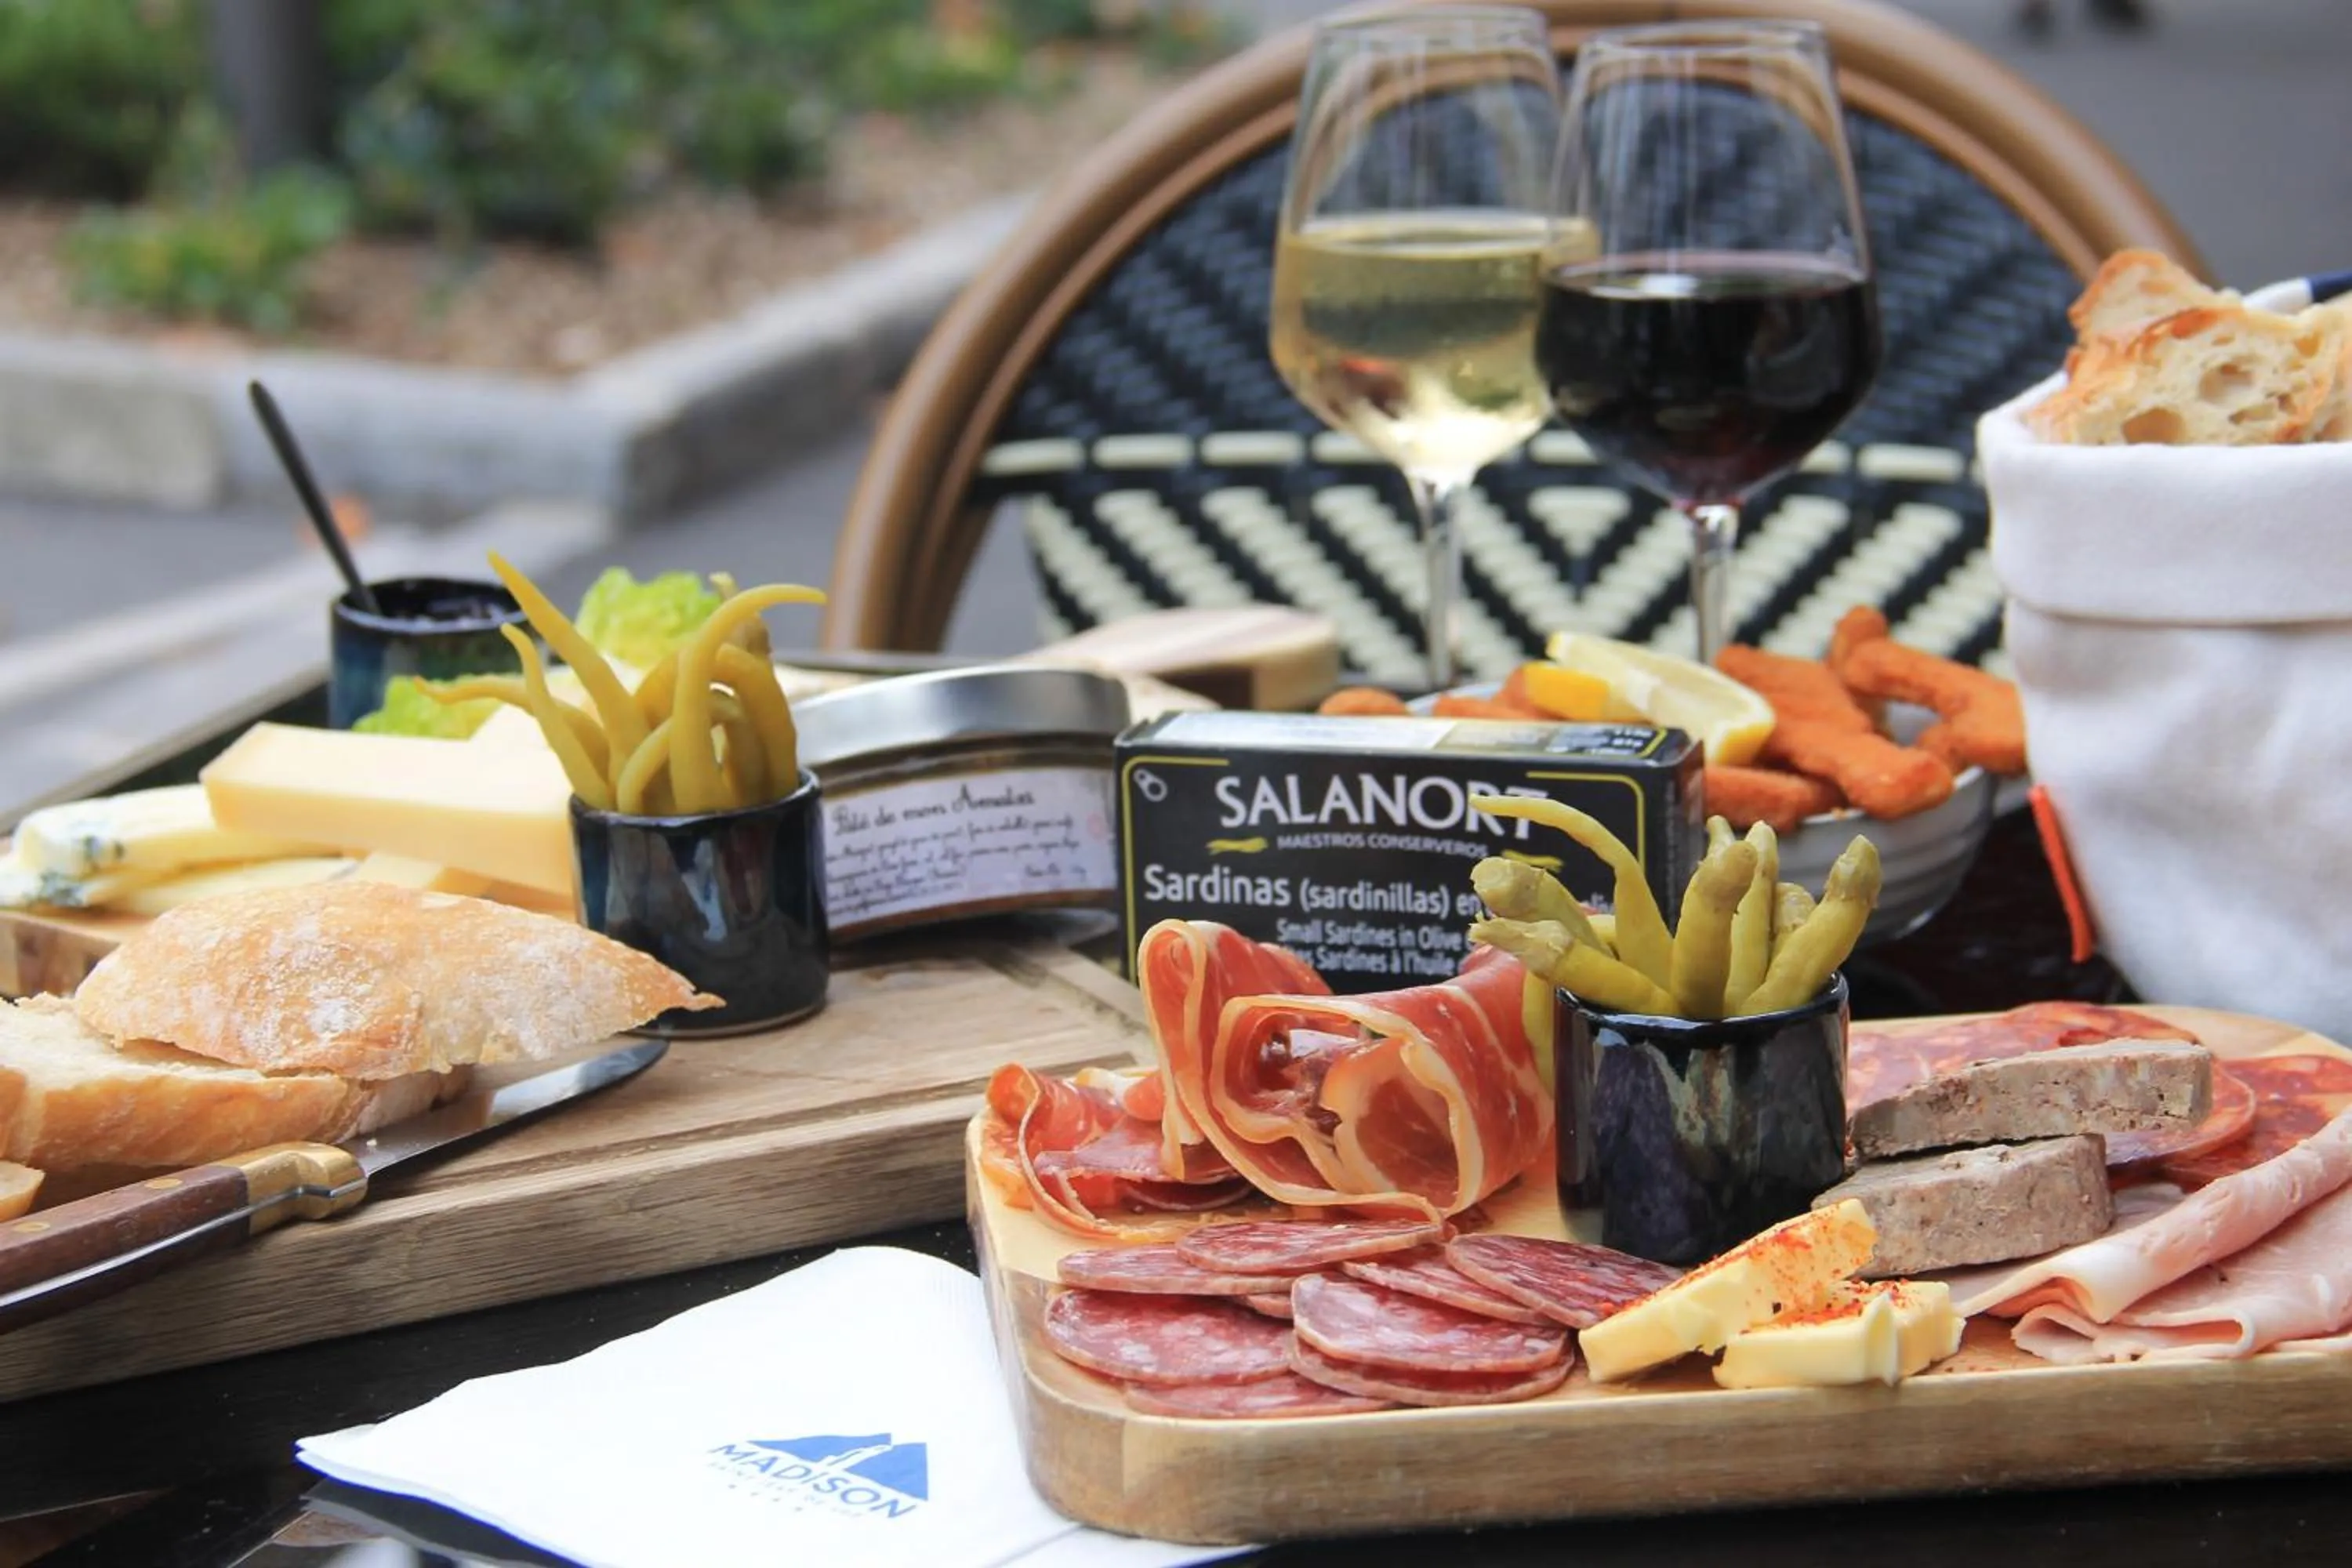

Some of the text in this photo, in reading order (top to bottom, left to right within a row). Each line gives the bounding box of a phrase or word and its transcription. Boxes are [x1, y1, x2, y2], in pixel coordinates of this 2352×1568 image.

[1215, 772, 1549, 840] SALANORT
[1276, 833, 1489, 858] MAESTROS CONSERVEROS
[1144, 864, 1292, 907] Sardinas
[1299, 877, 1450, 920] (sardinillas)
[1276, 917, 1323, 944] Small
[1325, 920, 1397, 949] Sardines
[1399, 923, 1416, 949] in
[1417, 925, 1461, 953] Olive
[1316, 945, 1388, 974] Sardines
[706, 1443, 918, 1519] MADISON
